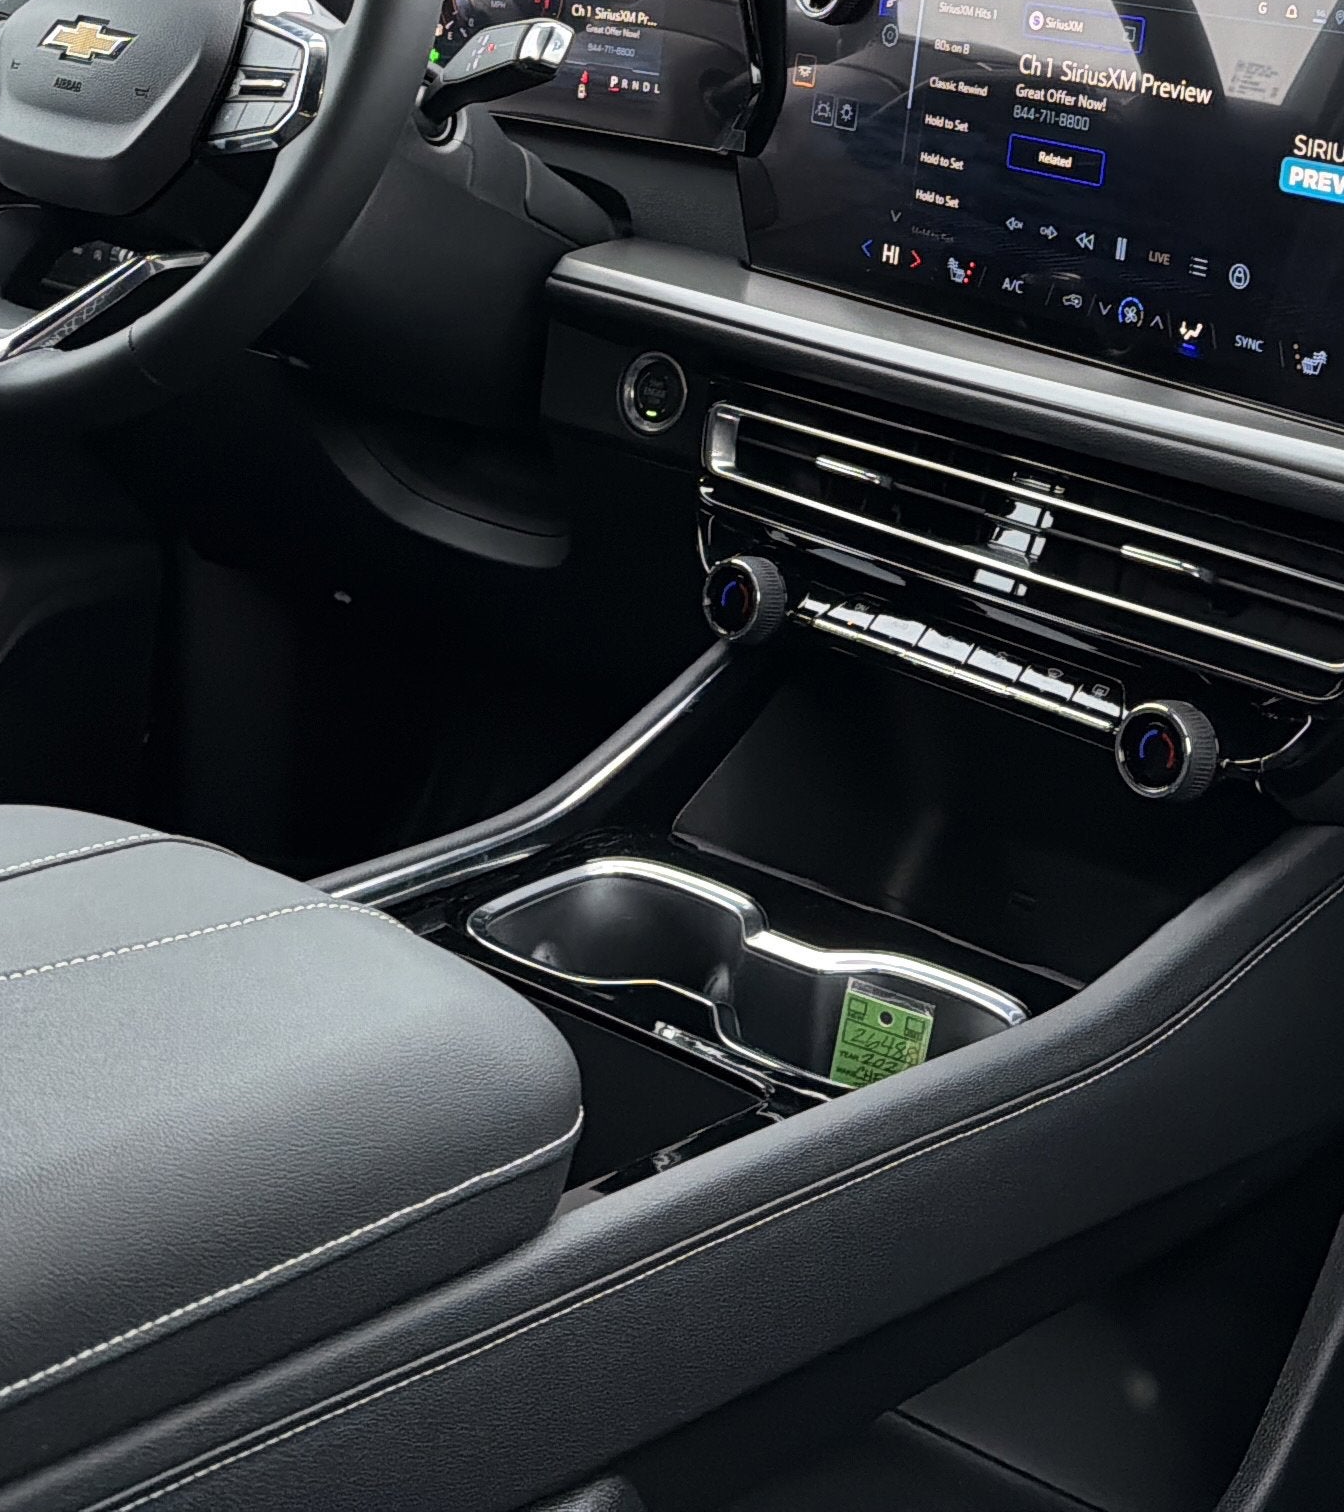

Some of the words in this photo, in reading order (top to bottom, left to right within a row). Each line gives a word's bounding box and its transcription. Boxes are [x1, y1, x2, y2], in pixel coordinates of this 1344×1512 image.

[571, 3, 585, 17] Ch
[587, 5, 592, 18] 1
[595, 6, 637, 23] SiriusXM
[938, 1, 974, 17] SiriusXM
[975, 5, 992, 20] Hits
[585, 24, 604, 34] Great
[604, 26, 622, 36] Offer
[1045, 16, 1084, 33] SiriusXM
[951, 44, 962, 54] on
[610, 75, 619, 88] P
[643, 81, 651, 92] D
[929, 76, 956, 93] Classic
[958, 81, 989, 98] Rewind
[1019, 53, 1042, 78] Ch
[1046, 57, 1053, 78] 1
[1060, 61, 1137, 94] SiriusXM
[1140, 73, 1213, 105] Preview
[1015, 83, 1045, 103] Great
[1046, 88, 1076, 106] Offer
[1078, 94, 1108, 112] Now!
[924, 113, 945, 129] Hold
[945, 116, 954, 131] to
[954, 119, 969, 133] Set
[1012, 104, 1090, 132] 844-711-8800
[919, 151, 940, 166] Hold
[940, 154, 949, 168] to
[949, 157, 965, 172] Set
[1038, 150, 1073, 169] Related
[915, 188, 936, 204] Hold
[935, 191, 945, 206] to
[945, 195, 960, 209] Set
[882, 242, 901, 266] HI
[1148, 249, 1171, 267] LIVE
[1002, 277, 1025, 294] A/C
[1234, 333, 1265, 354] SYNC
